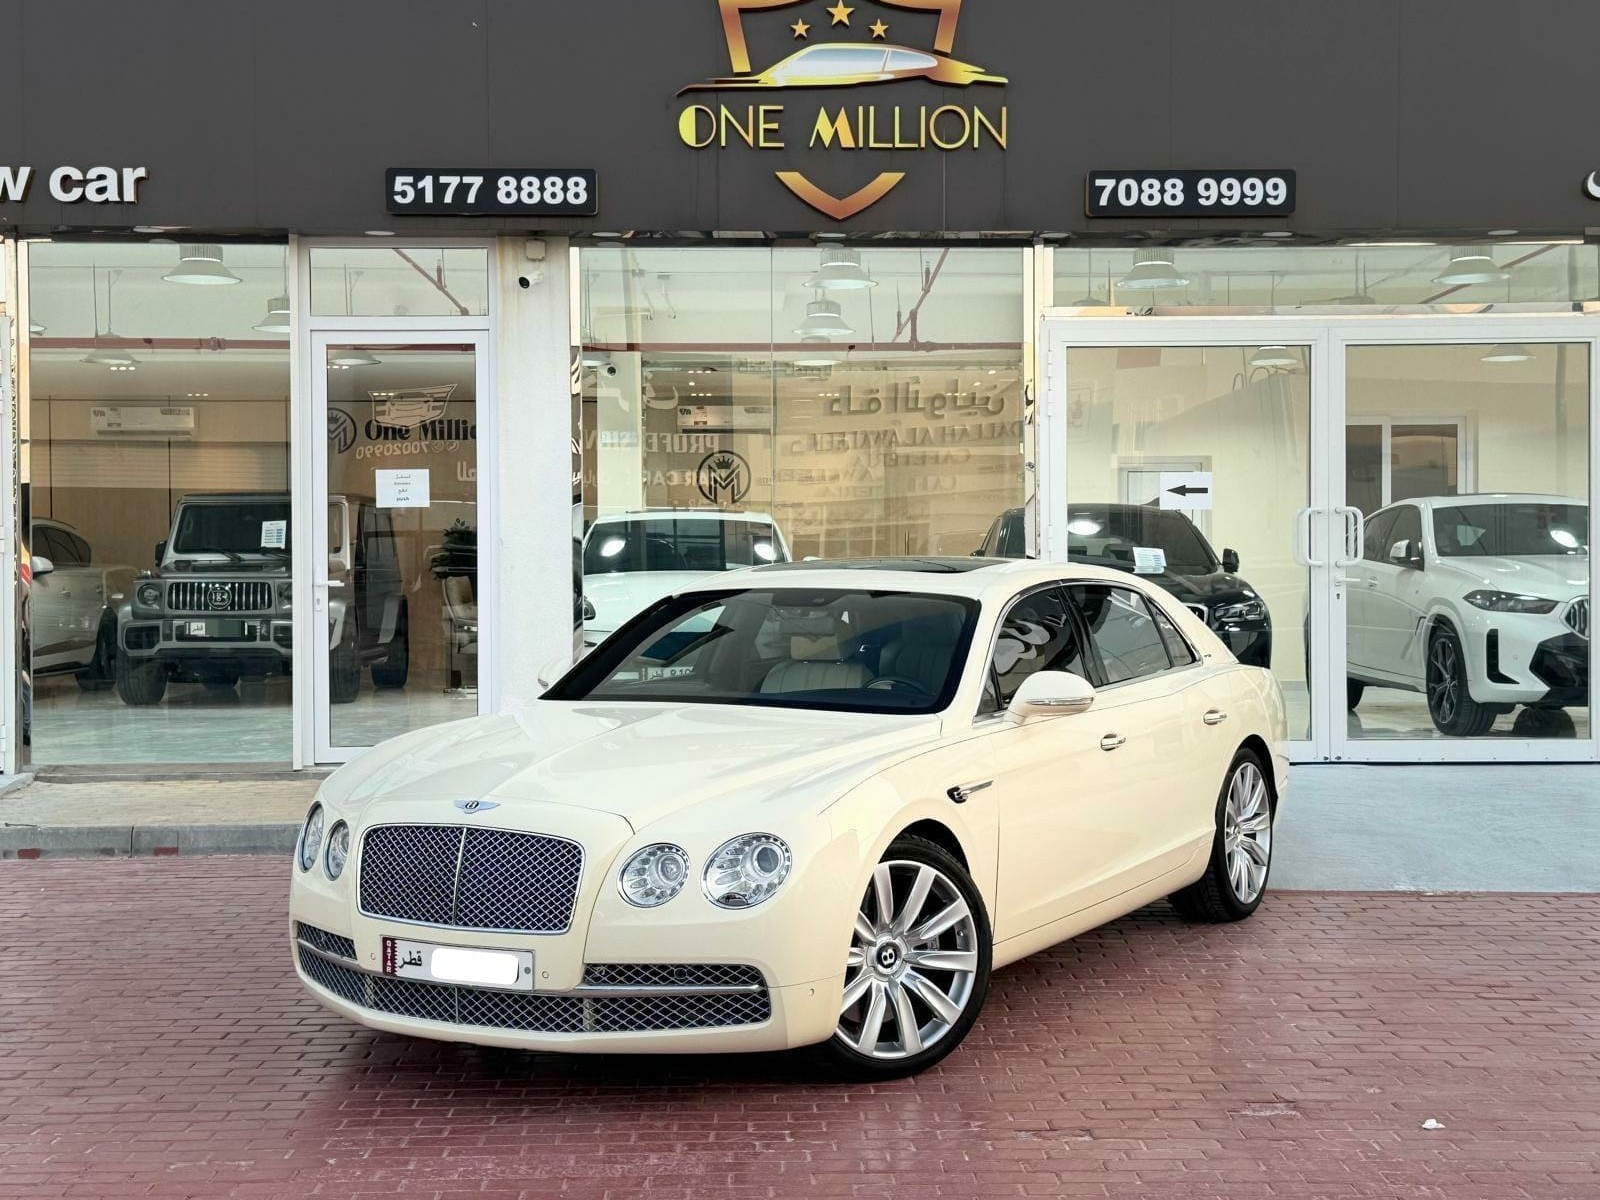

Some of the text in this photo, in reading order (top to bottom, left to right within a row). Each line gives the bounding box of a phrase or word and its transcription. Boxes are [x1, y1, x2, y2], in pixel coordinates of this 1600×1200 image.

[679, 104, 1007, 150] ONE MILLION
[49, 166, 147, 203] car
[393, 175, 588, 204] 5177 8888
[1095, 178, 1287, 206] 7088 9999
[365, 418, 412, 441] One
[398, 950, 423, 969] قطر
